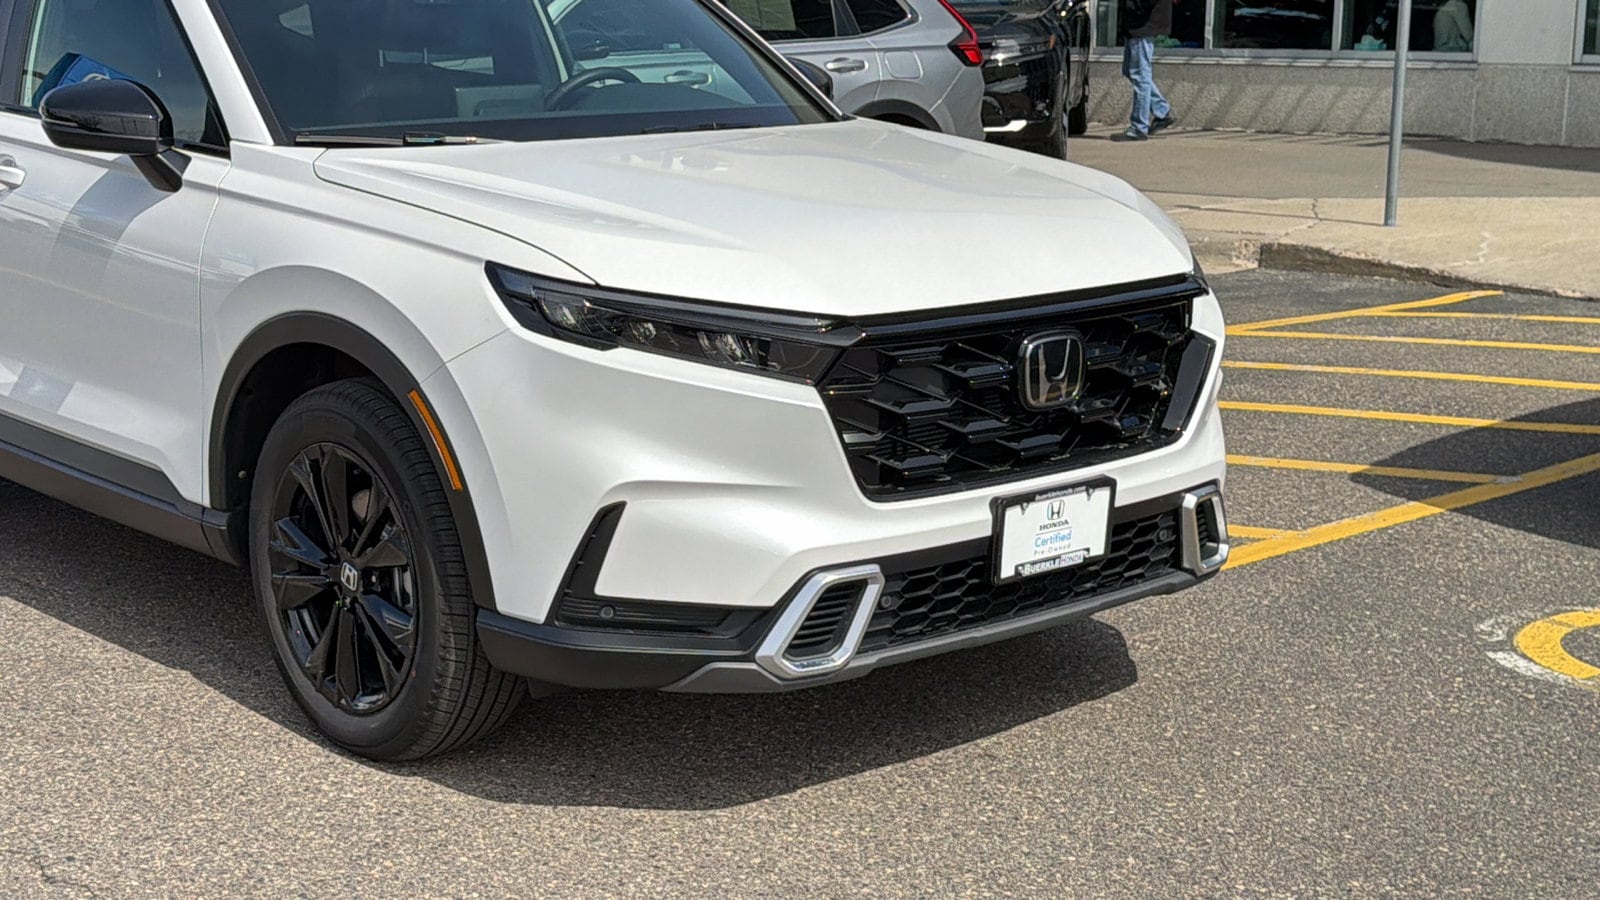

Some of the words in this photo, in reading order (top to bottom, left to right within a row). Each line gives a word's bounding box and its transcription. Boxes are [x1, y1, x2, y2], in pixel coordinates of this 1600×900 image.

[1039, 519, 1069, 531] HONDA
[1035, 529, 1072, 547] Certified
[1034, 542, 1071, 556] Pre-Owned
